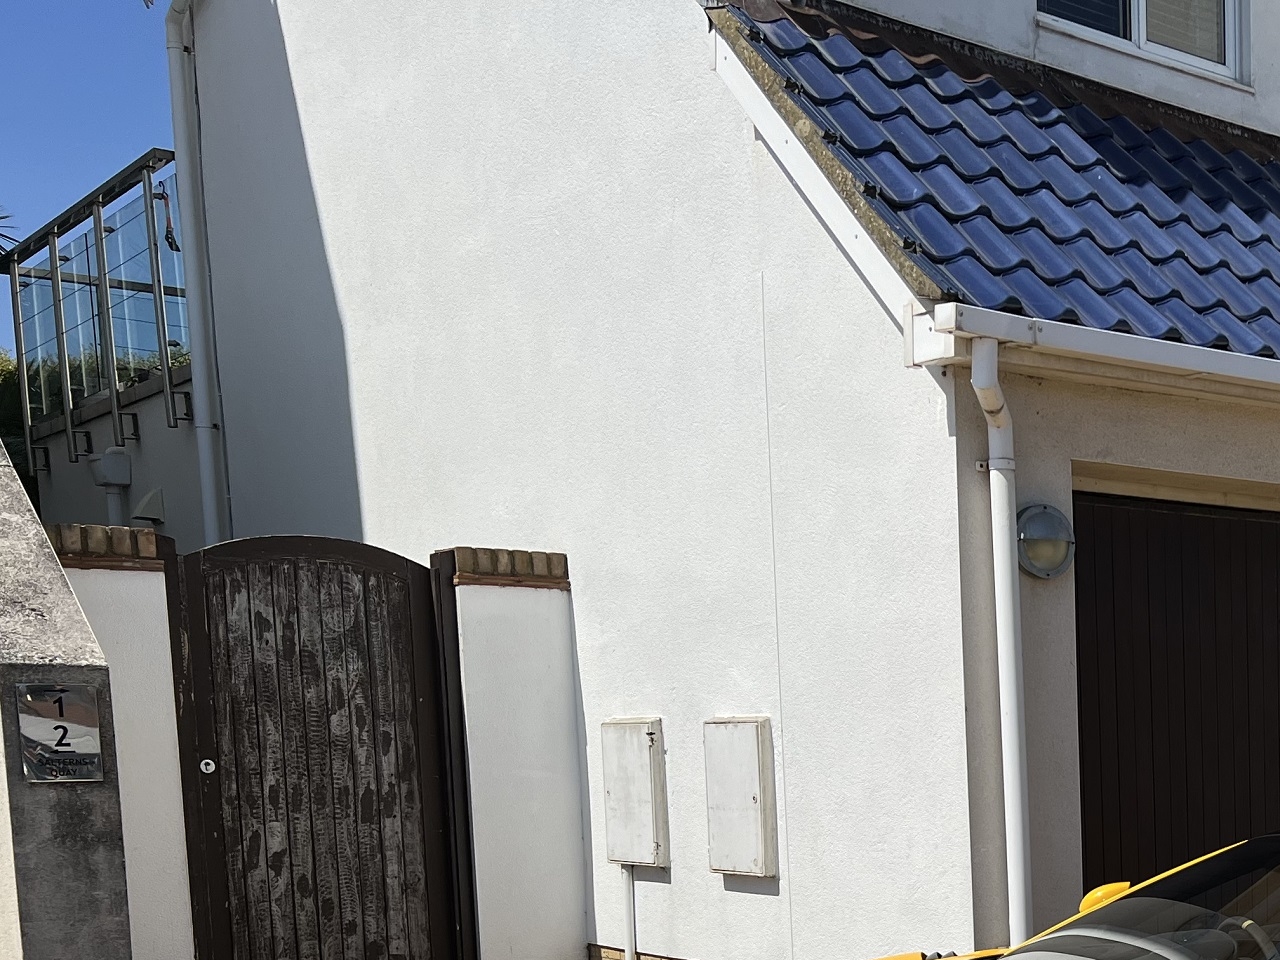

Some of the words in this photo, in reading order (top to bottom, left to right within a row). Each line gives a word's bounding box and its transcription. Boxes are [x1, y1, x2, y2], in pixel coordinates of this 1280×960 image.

[52, 696, 64, 718] 1
[52, 724, 71, 747] 2
[38, 757, 88, 767] SALTERNS
[50, 768, 78, 778] QUAY
